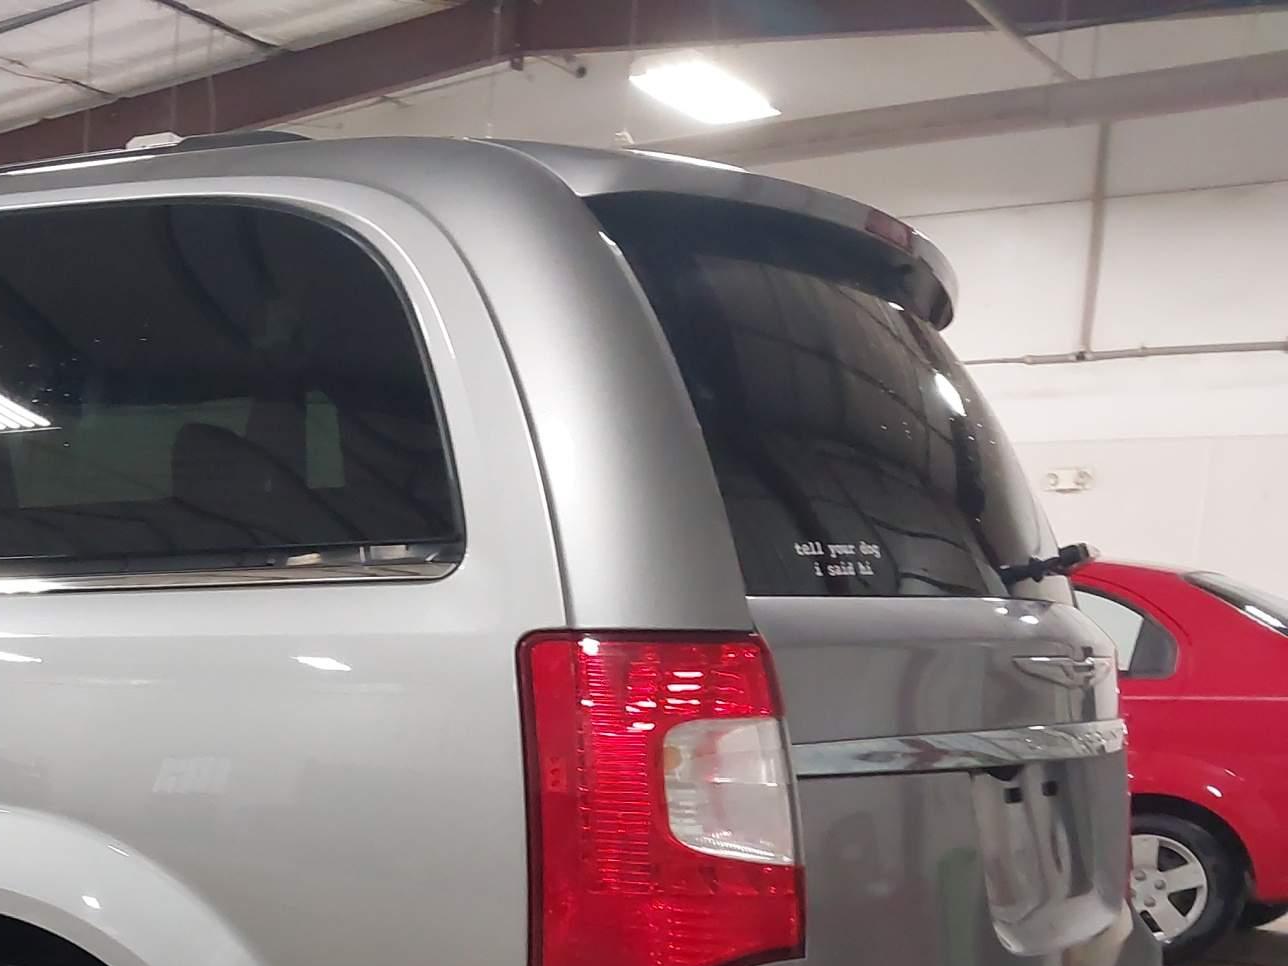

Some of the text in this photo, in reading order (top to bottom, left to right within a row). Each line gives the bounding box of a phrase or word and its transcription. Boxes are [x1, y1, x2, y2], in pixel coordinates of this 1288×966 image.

[794, 541, 824, 556] tell
[858, 540, 881, 559] dog
[814, 561, 874, 577] i said hi
